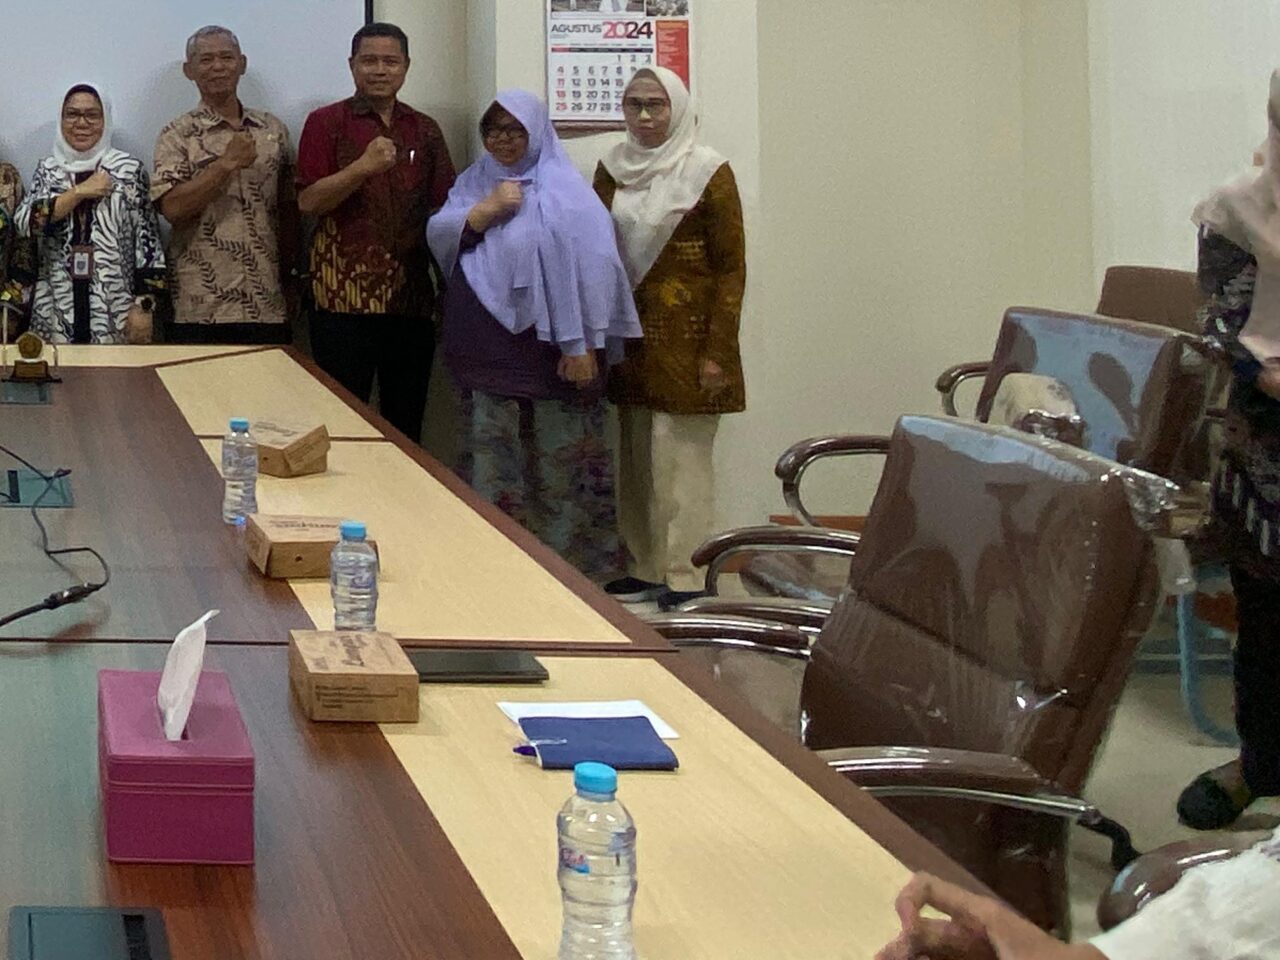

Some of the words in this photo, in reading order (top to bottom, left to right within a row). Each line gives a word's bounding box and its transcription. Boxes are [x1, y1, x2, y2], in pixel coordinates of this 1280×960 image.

[551, 24, 602, 33] AGUSTUS
[602, 21, 654, 39] 2024
[630, 54, 636, 63] 2
[557, 66, 564, 74] 4
[573, 66, 579, 74] 5
[588, 66, 594, 74] 6
[602, 66, 608, 74] 7
[616, 66, 622, 74] 8
[557, 78, 564, 87] 11
[572, 78, 580, 87] 12
[587, 78, 596, 87] 13
[600, 78, 610, 87] 14
[615, 78, 624, 87] 15
[556, 91, 566, 99] 18
[572, 91, 581, 99] 19
[586, 91, 598, 99] 20
[601, 91, 610, 99] 21
[556, 103, 567, 112] 25
[571, 103, 583, 112] 26
[586, 103, 597, 112] 27
[600, 103, 611, 112] 28
